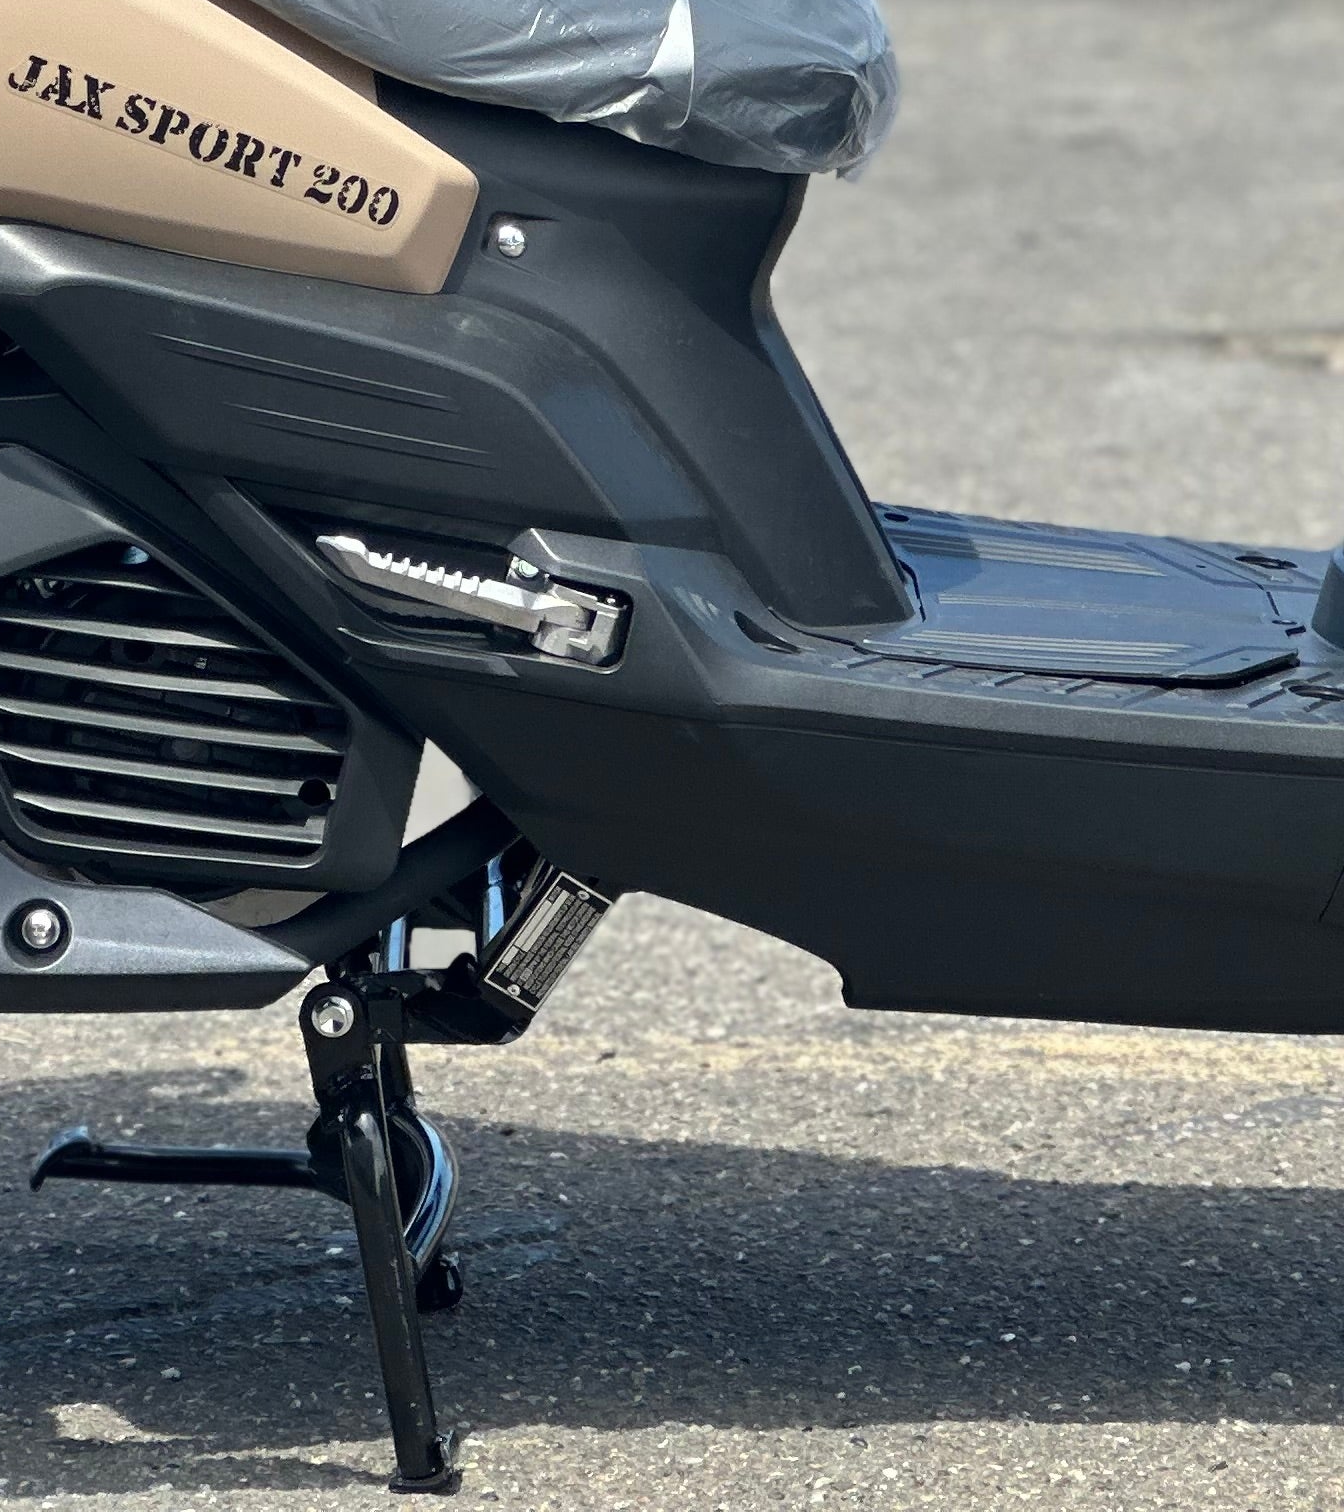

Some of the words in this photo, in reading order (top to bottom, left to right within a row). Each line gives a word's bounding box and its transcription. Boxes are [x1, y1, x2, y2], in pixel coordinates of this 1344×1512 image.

[7, 55, 115, 120] JAX
[116, 93, 301, 188] SPORT
[304, 164, 400, 225] 200
